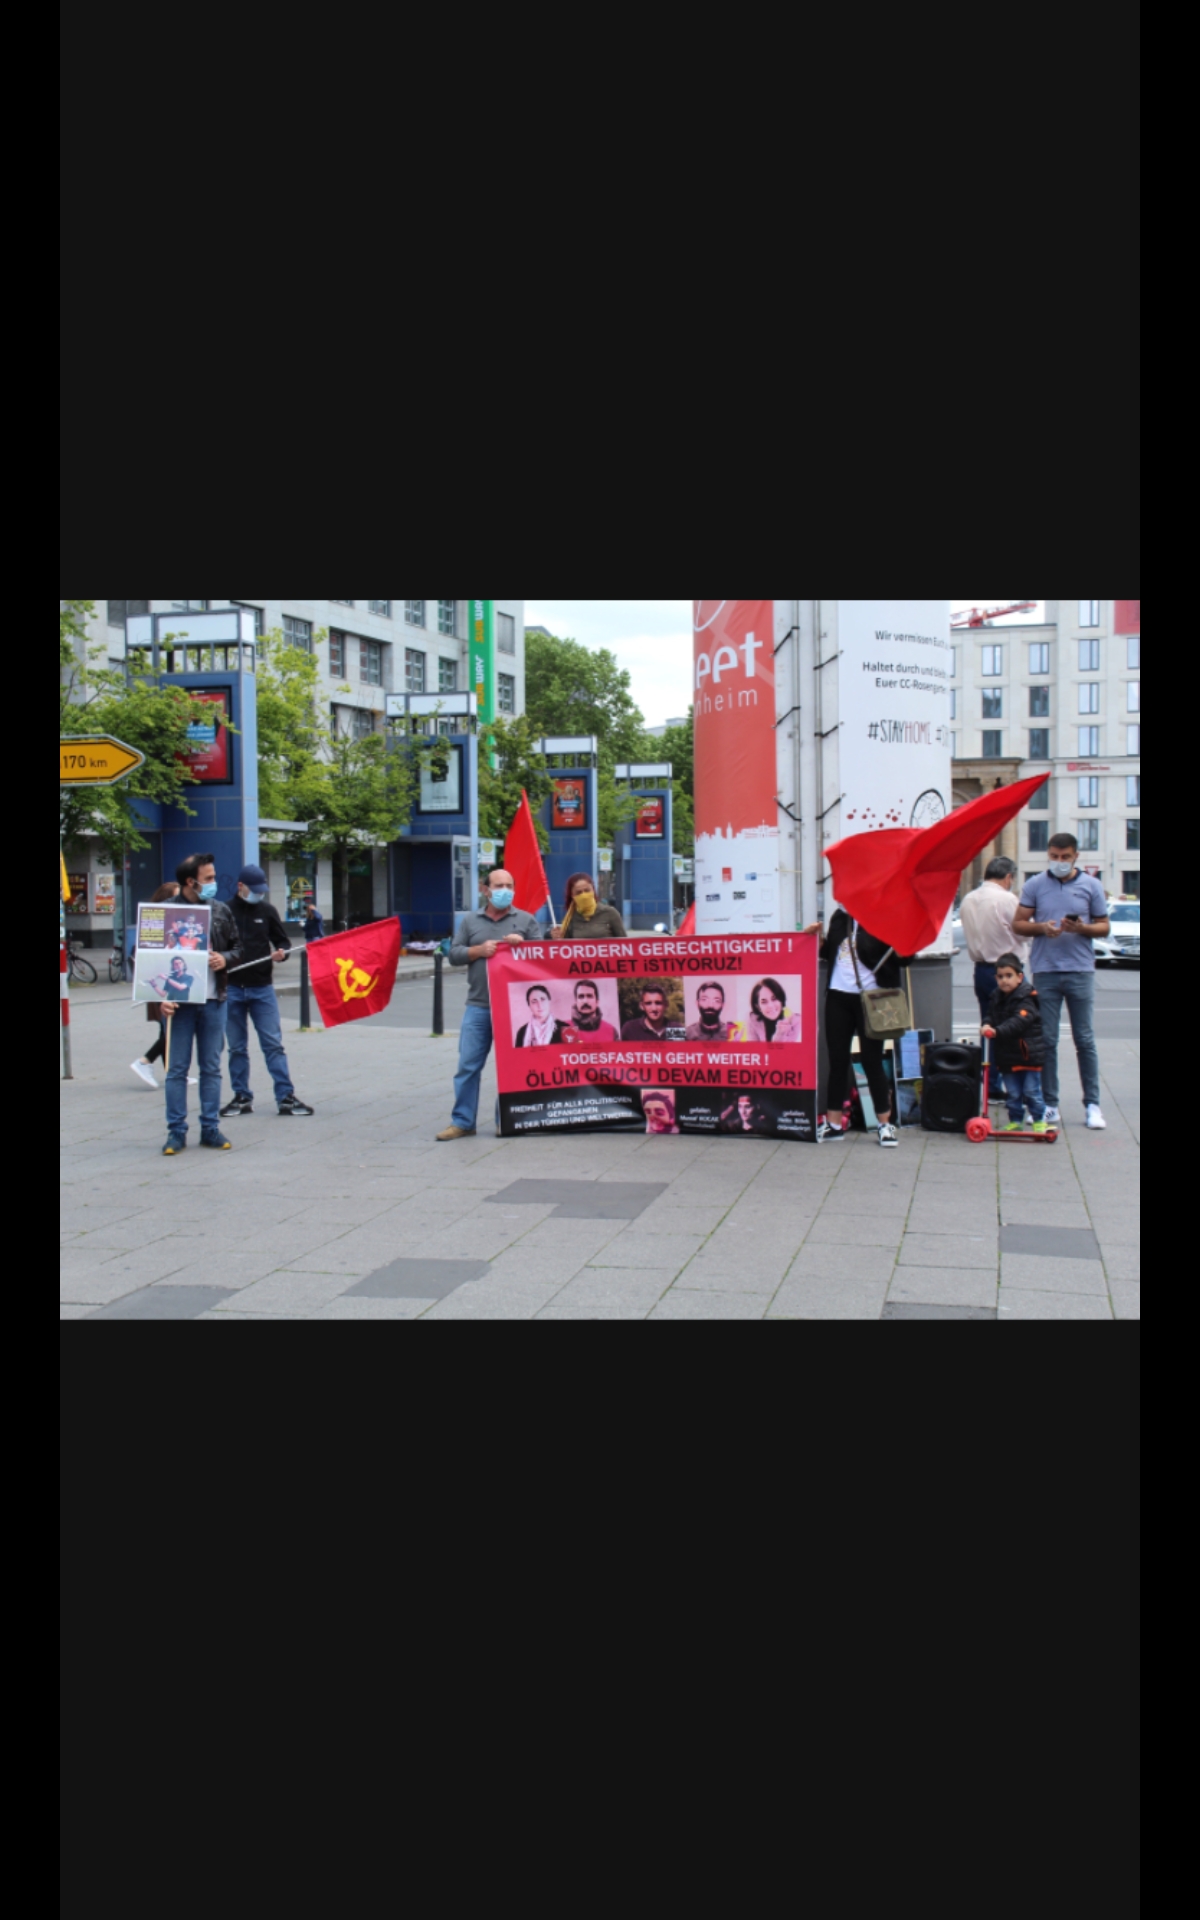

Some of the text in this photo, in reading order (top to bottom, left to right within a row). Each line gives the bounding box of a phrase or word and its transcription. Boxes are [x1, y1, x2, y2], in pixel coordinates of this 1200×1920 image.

[875, 630, 891, 640] Wir
[894, 631, 932, 645] vermissen
[863, 661, 894, 673] Haltet
[896, 662, 920, 675] durch
[921, 667, 933, 677] und
[475, 654, 485, 706] SUBWAY
[876, 677, 897, 688] Euer
[867, 719, 932, 745] #STAYHOME
[63, 755, 108, 769] 170 km
[511, 938, 793, 961] WIR FORDERN GERECHTIGKEIT !
[568, 959, 638, 975] ADALET
[560, 1051, 769, 1066] TODESFASTEN GEHT WEITER !
[526, 1067, 580, 1088] ÖLÜM
[585, 1067, 652, 1083] ORUCU
[657, 1068, 721, 1084] DEVAM
[510, 1103, 544, 1114] FREIHEIT
[547, 1101, 562, 1110] FÜR
[523, 1120, 540, 1128] DER
[541, 1117, 569, 1127] TÜRKEI
[569, 1115, 586, 1125] UND
